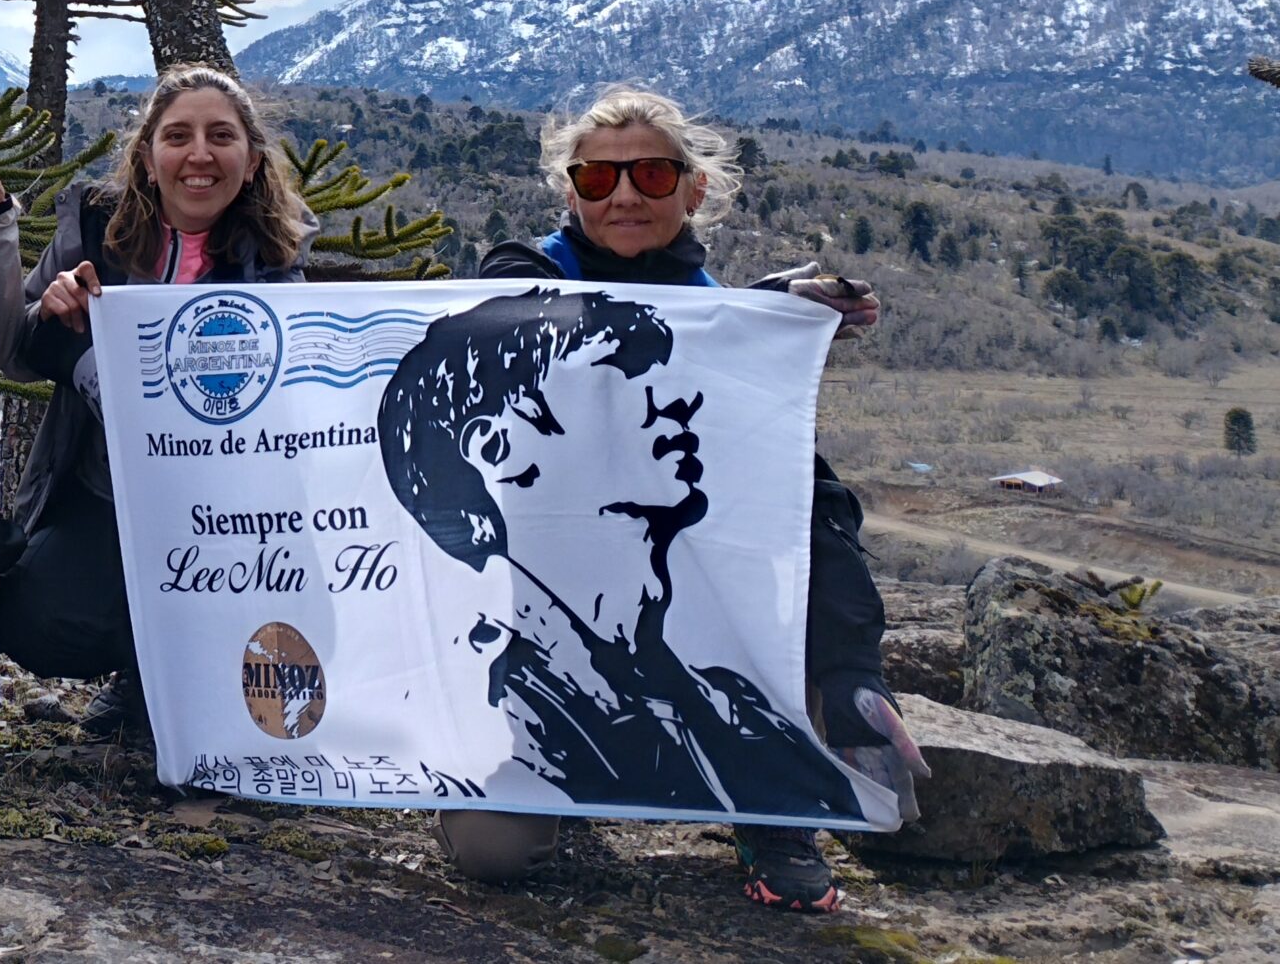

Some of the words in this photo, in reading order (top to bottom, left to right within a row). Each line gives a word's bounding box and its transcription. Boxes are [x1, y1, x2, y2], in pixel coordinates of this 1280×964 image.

[188, 339, 236, 355] MINOZ
[238, 338, 259, 352] DE
[173, 352, 274, 373] ARGENTINA
[203, 396, 241, 416] 이민호
[147, 433, 213, 457] Minoz
[220, 430, 246, 455] de
[254, 422, 378, 459] Argentina
[191, 504, 303, 544] Siempre
[313, 506, 369, 532] con
[328, 541, 400, 593] Ho
[242, 662, 323, 690] MINOZ
[333, 770, 357, 799] 미
[369, 772, 421, 795] 노즈
